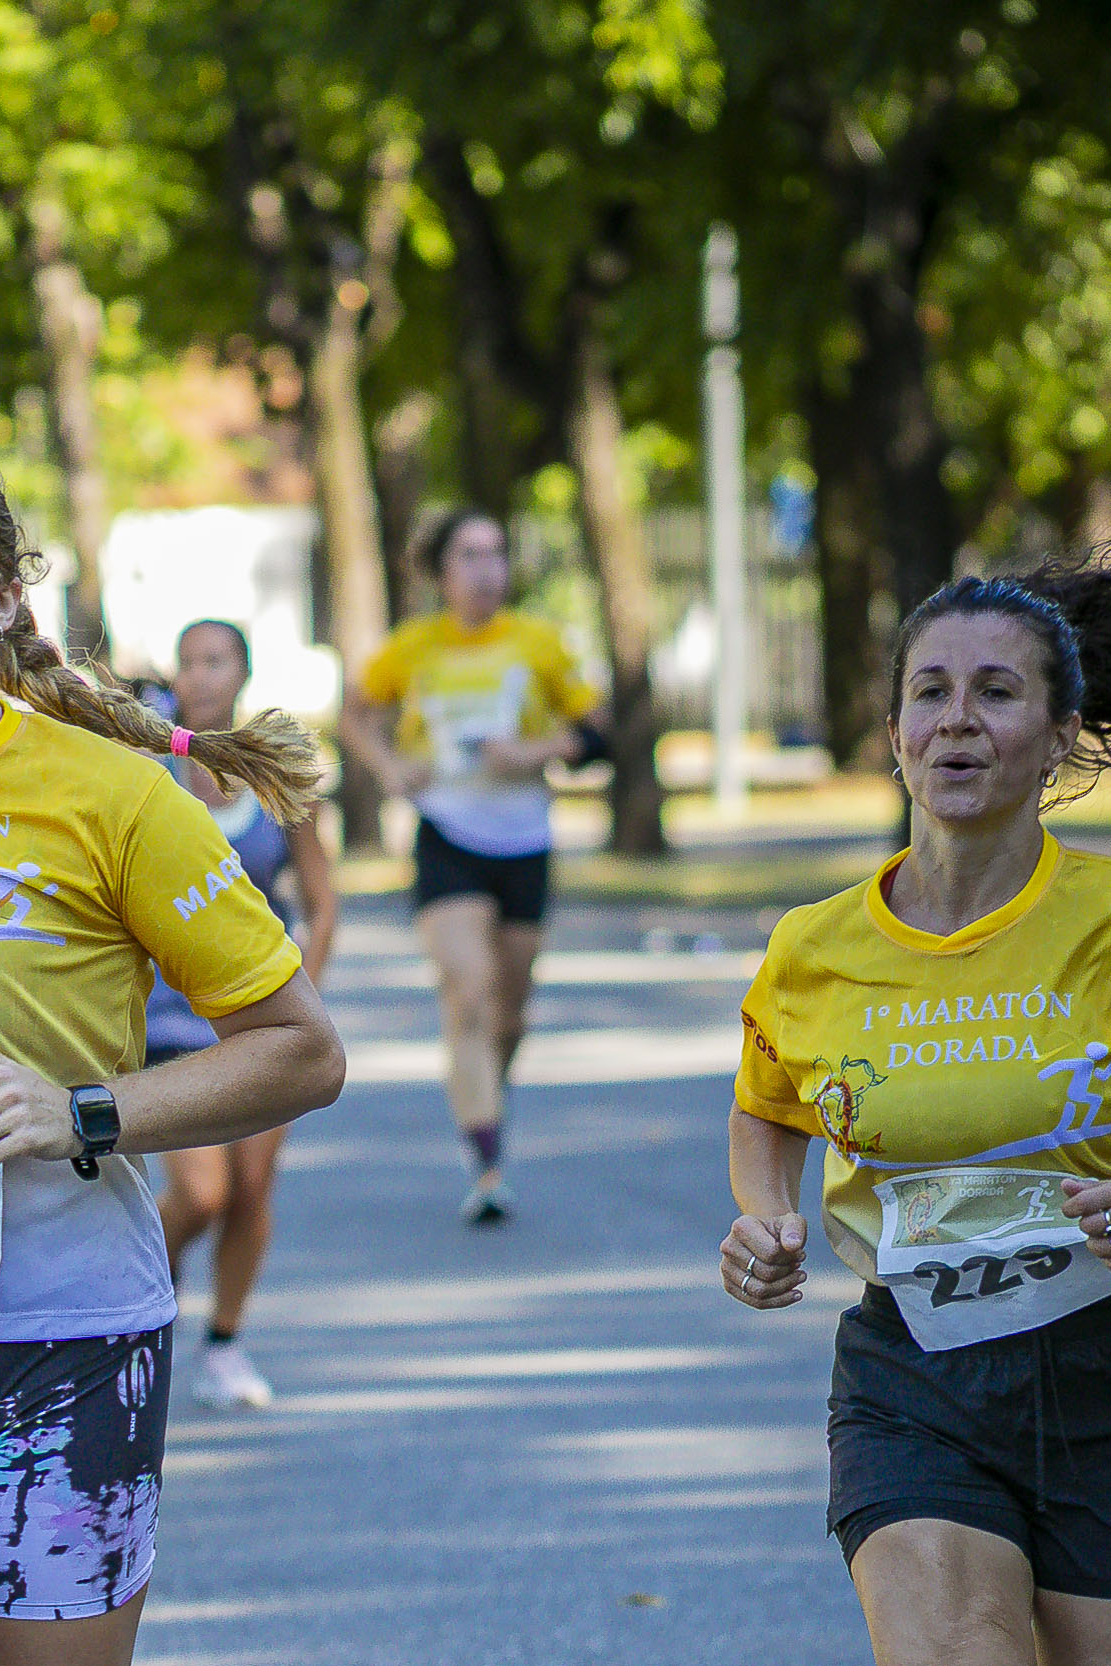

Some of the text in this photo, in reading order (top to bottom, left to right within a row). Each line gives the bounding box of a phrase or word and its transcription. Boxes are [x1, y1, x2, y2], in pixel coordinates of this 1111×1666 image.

[896, 983, 1074, 1028] MARATÓN
[886, 1033, 1041, 1069] DORADA
[958, 1186, 1005, 1198] DORADA
